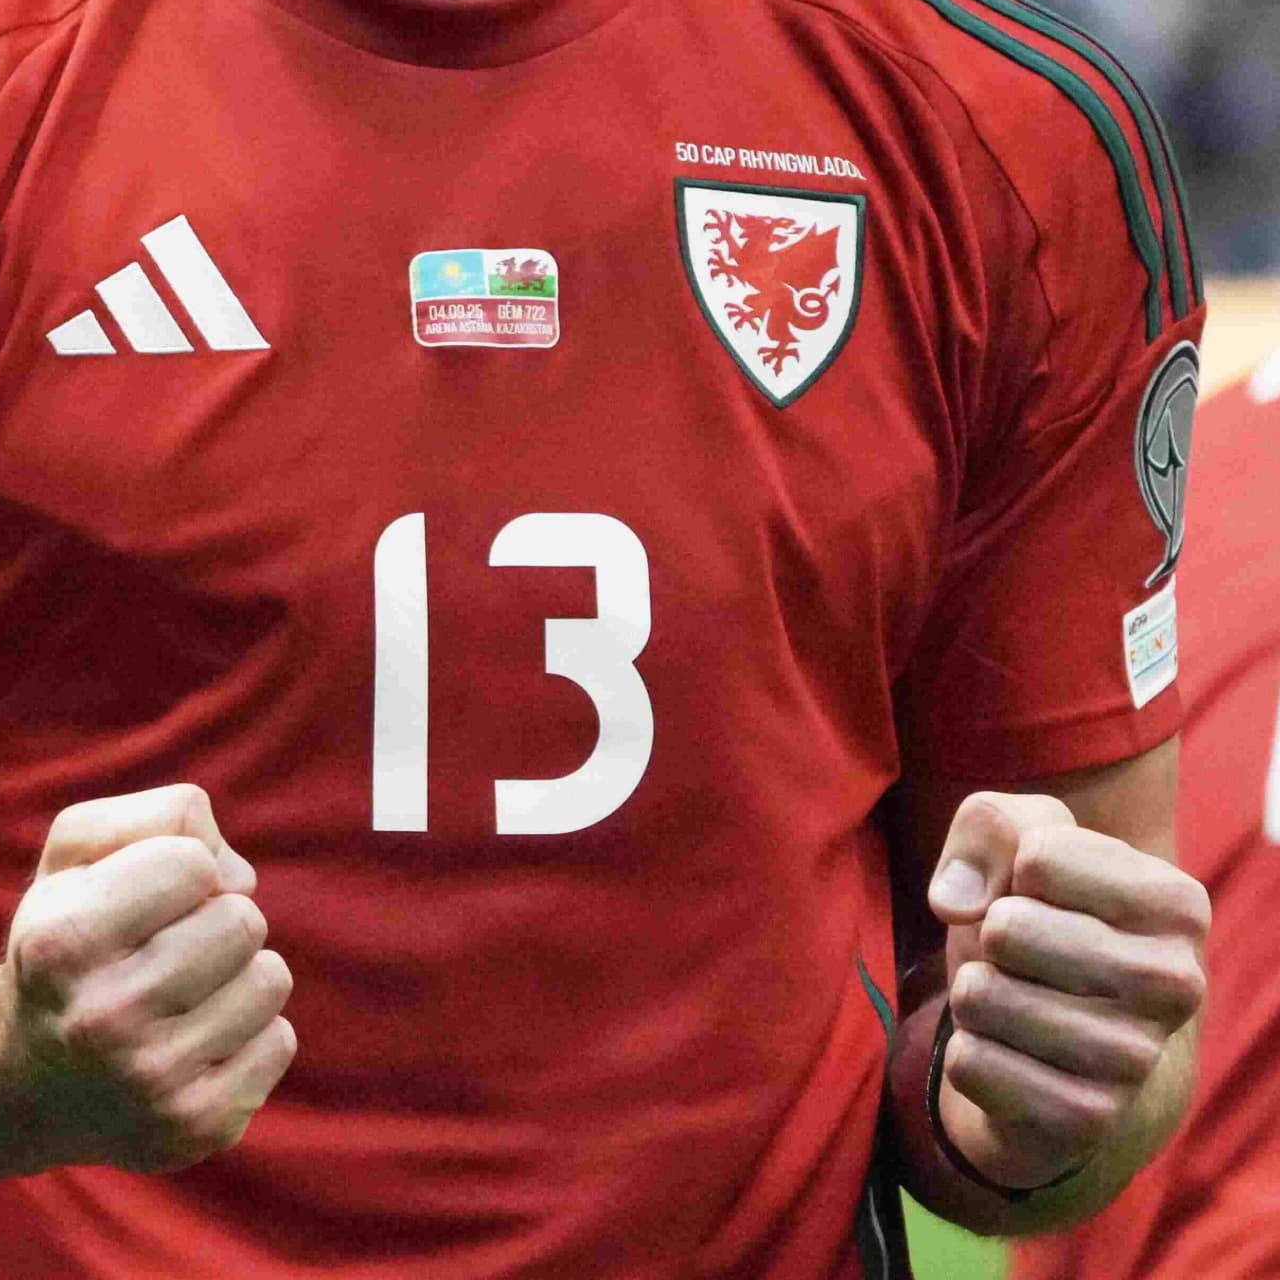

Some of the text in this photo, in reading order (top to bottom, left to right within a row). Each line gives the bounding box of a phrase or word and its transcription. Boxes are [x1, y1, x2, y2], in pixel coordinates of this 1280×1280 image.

[675, 142, 699, 163] 50
[702, 145, 736, 167] CAP
[429, 304, 484, 321] 04.09.25
[525, 304, 547, 321] 722
[425, 321, 457, 335] ARENA
[372, 511, 654, 835] 13
